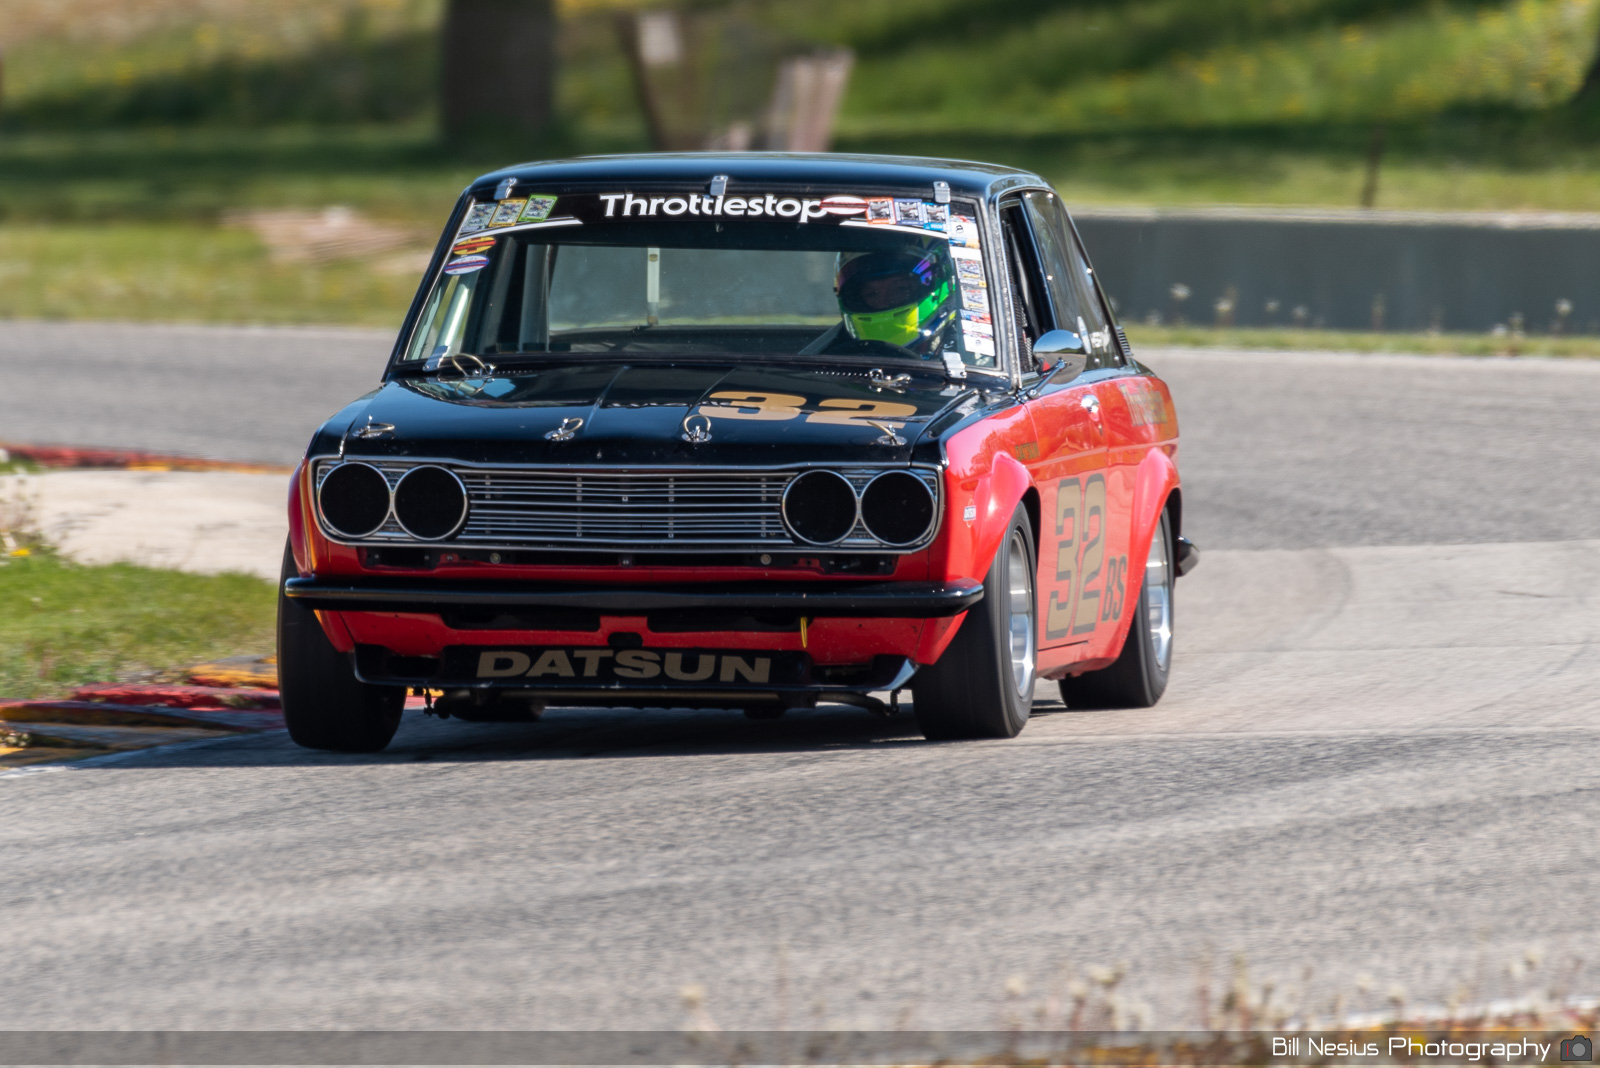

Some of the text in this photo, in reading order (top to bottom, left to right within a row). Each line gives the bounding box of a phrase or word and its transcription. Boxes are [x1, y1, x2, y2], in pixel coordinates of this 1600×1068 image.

[600, 193, 828, 223] Throttlestop
[698, 391, 918, 429] 32
[1046, 473, 1128, 641] 32 BS
[476, 650, 771, 683] DATSUN
